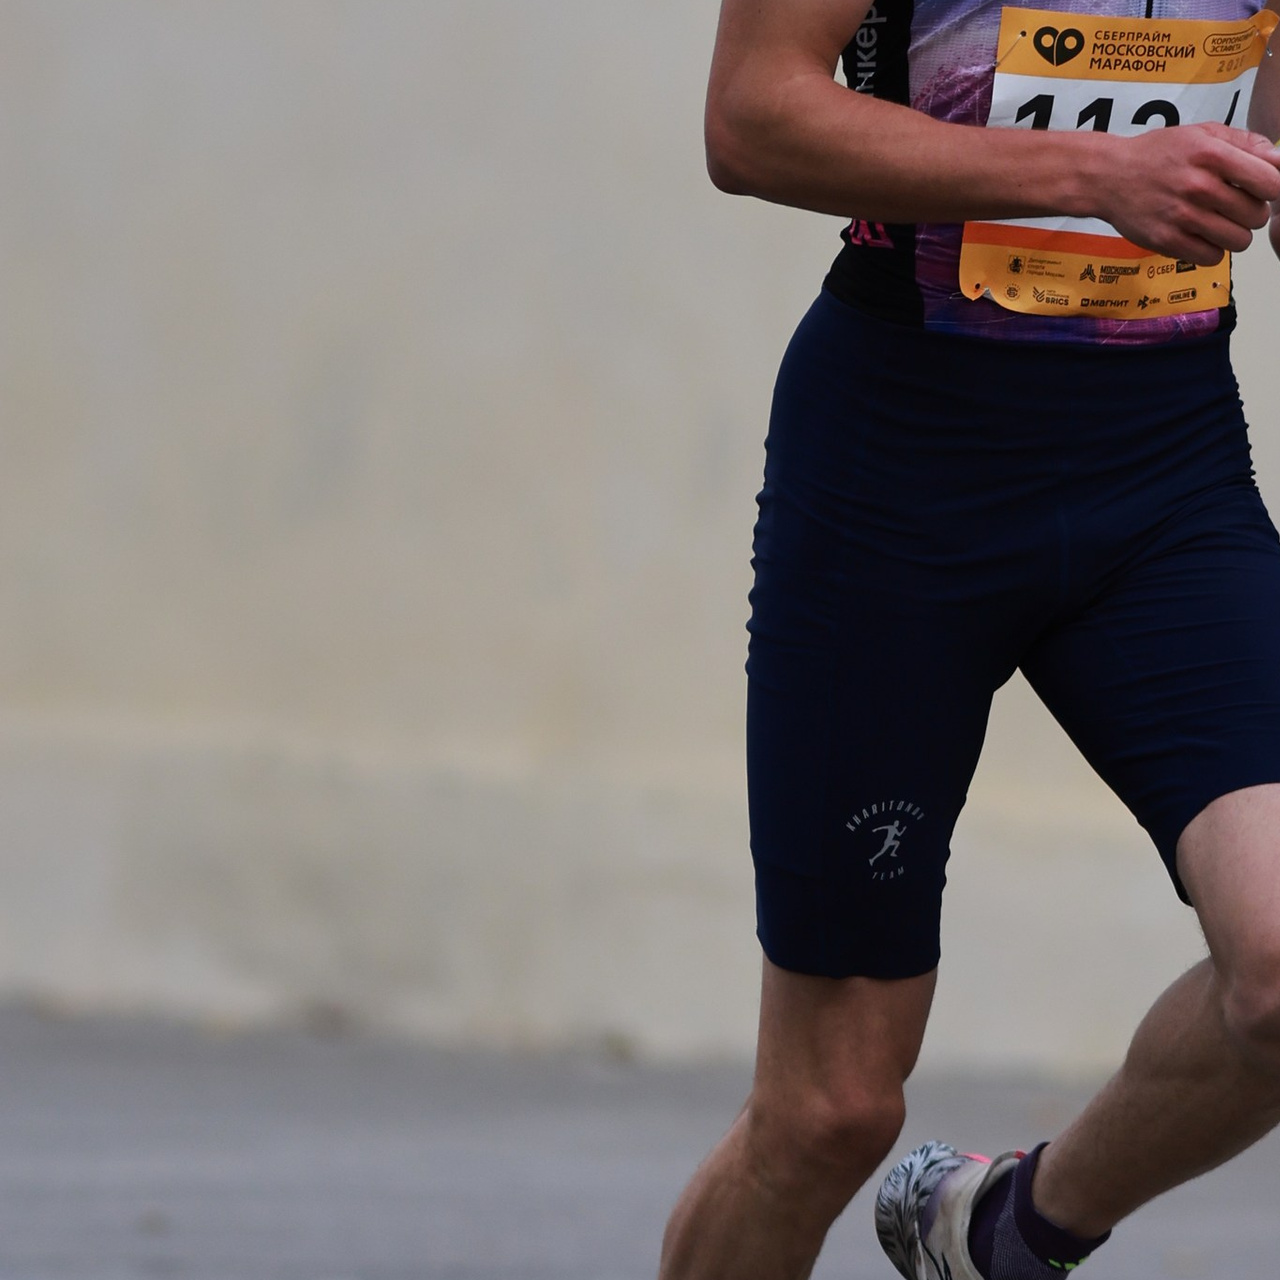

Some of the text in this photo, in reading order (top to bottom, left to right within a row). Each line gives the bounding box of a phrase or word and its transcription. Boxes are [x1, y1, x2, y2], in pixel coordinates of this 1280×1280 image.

[1094, 30, 1171, 42] СБЕРПРАЙМ
[1092, 43, 1196, 58] МОСКОВСКИЙ
[1089, 58, 1167, 72] МАРАФОН
[1156, 264, 1175, 275] СБЕР
[1045, 296, 1069, 306] BRICS
